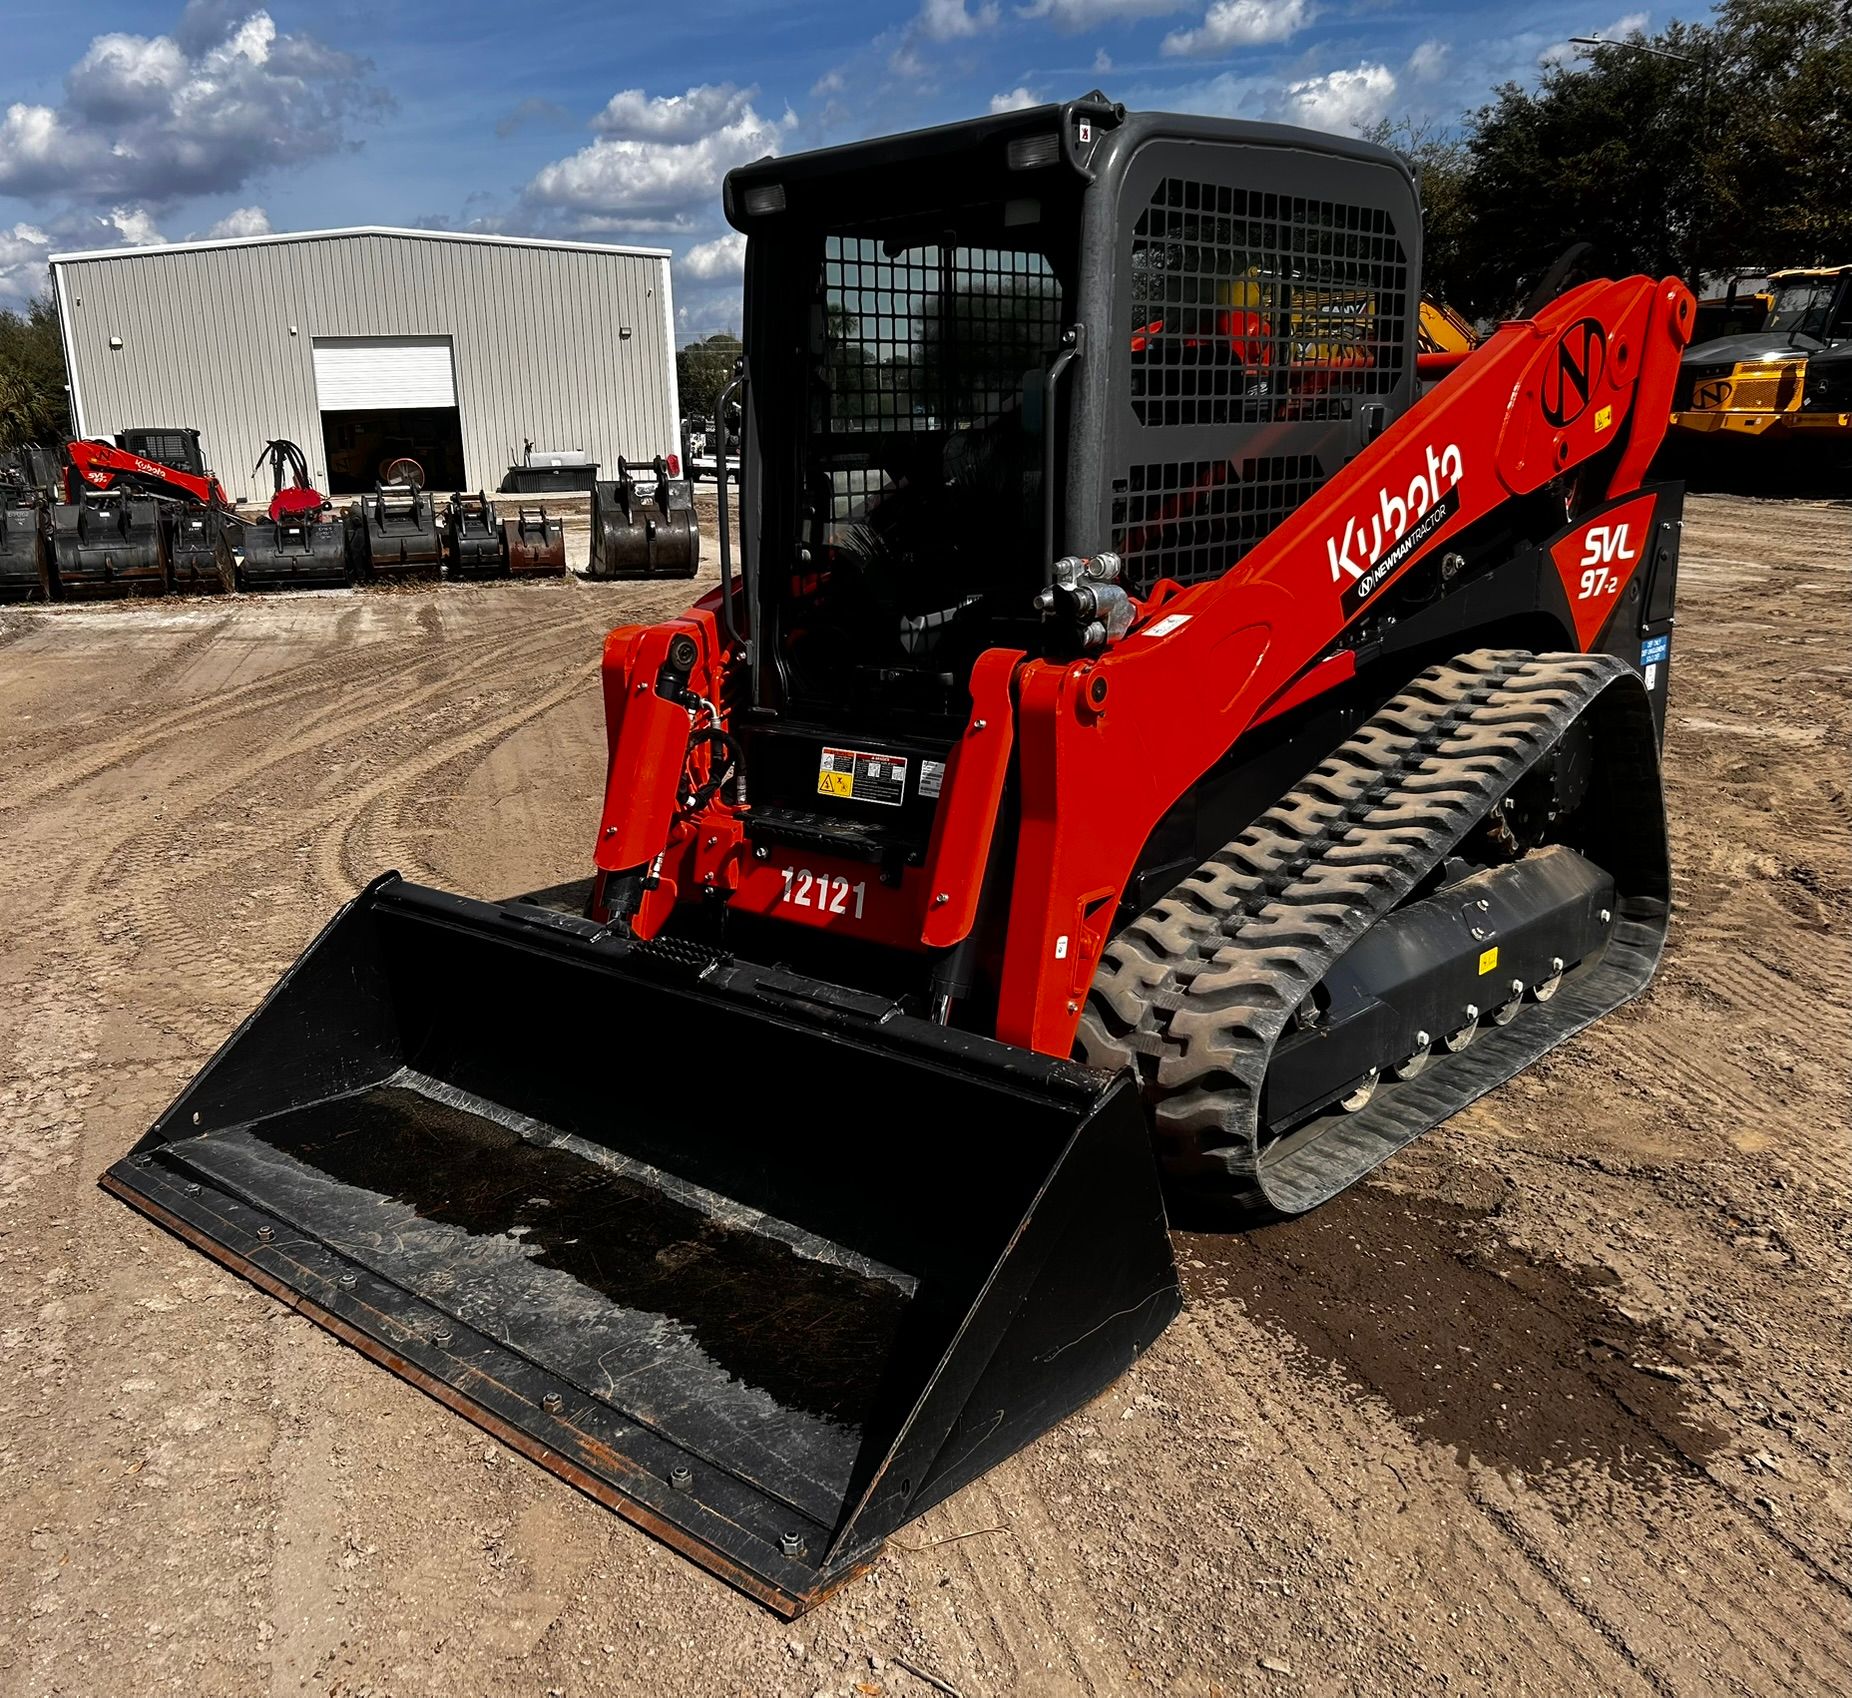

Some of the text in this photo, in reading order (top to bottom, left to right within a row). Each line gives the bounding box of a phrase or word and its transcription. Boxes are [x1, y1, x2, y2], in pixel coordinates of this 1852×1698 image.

[134, 458, 166, 478] Kubota
[1326, 443, 1464, 583] Kubota
[1580, 523, 1635, 567] SVL
[1577, 567, 1618, 600] 97-2
[781, 866, 866, 919] 12121
